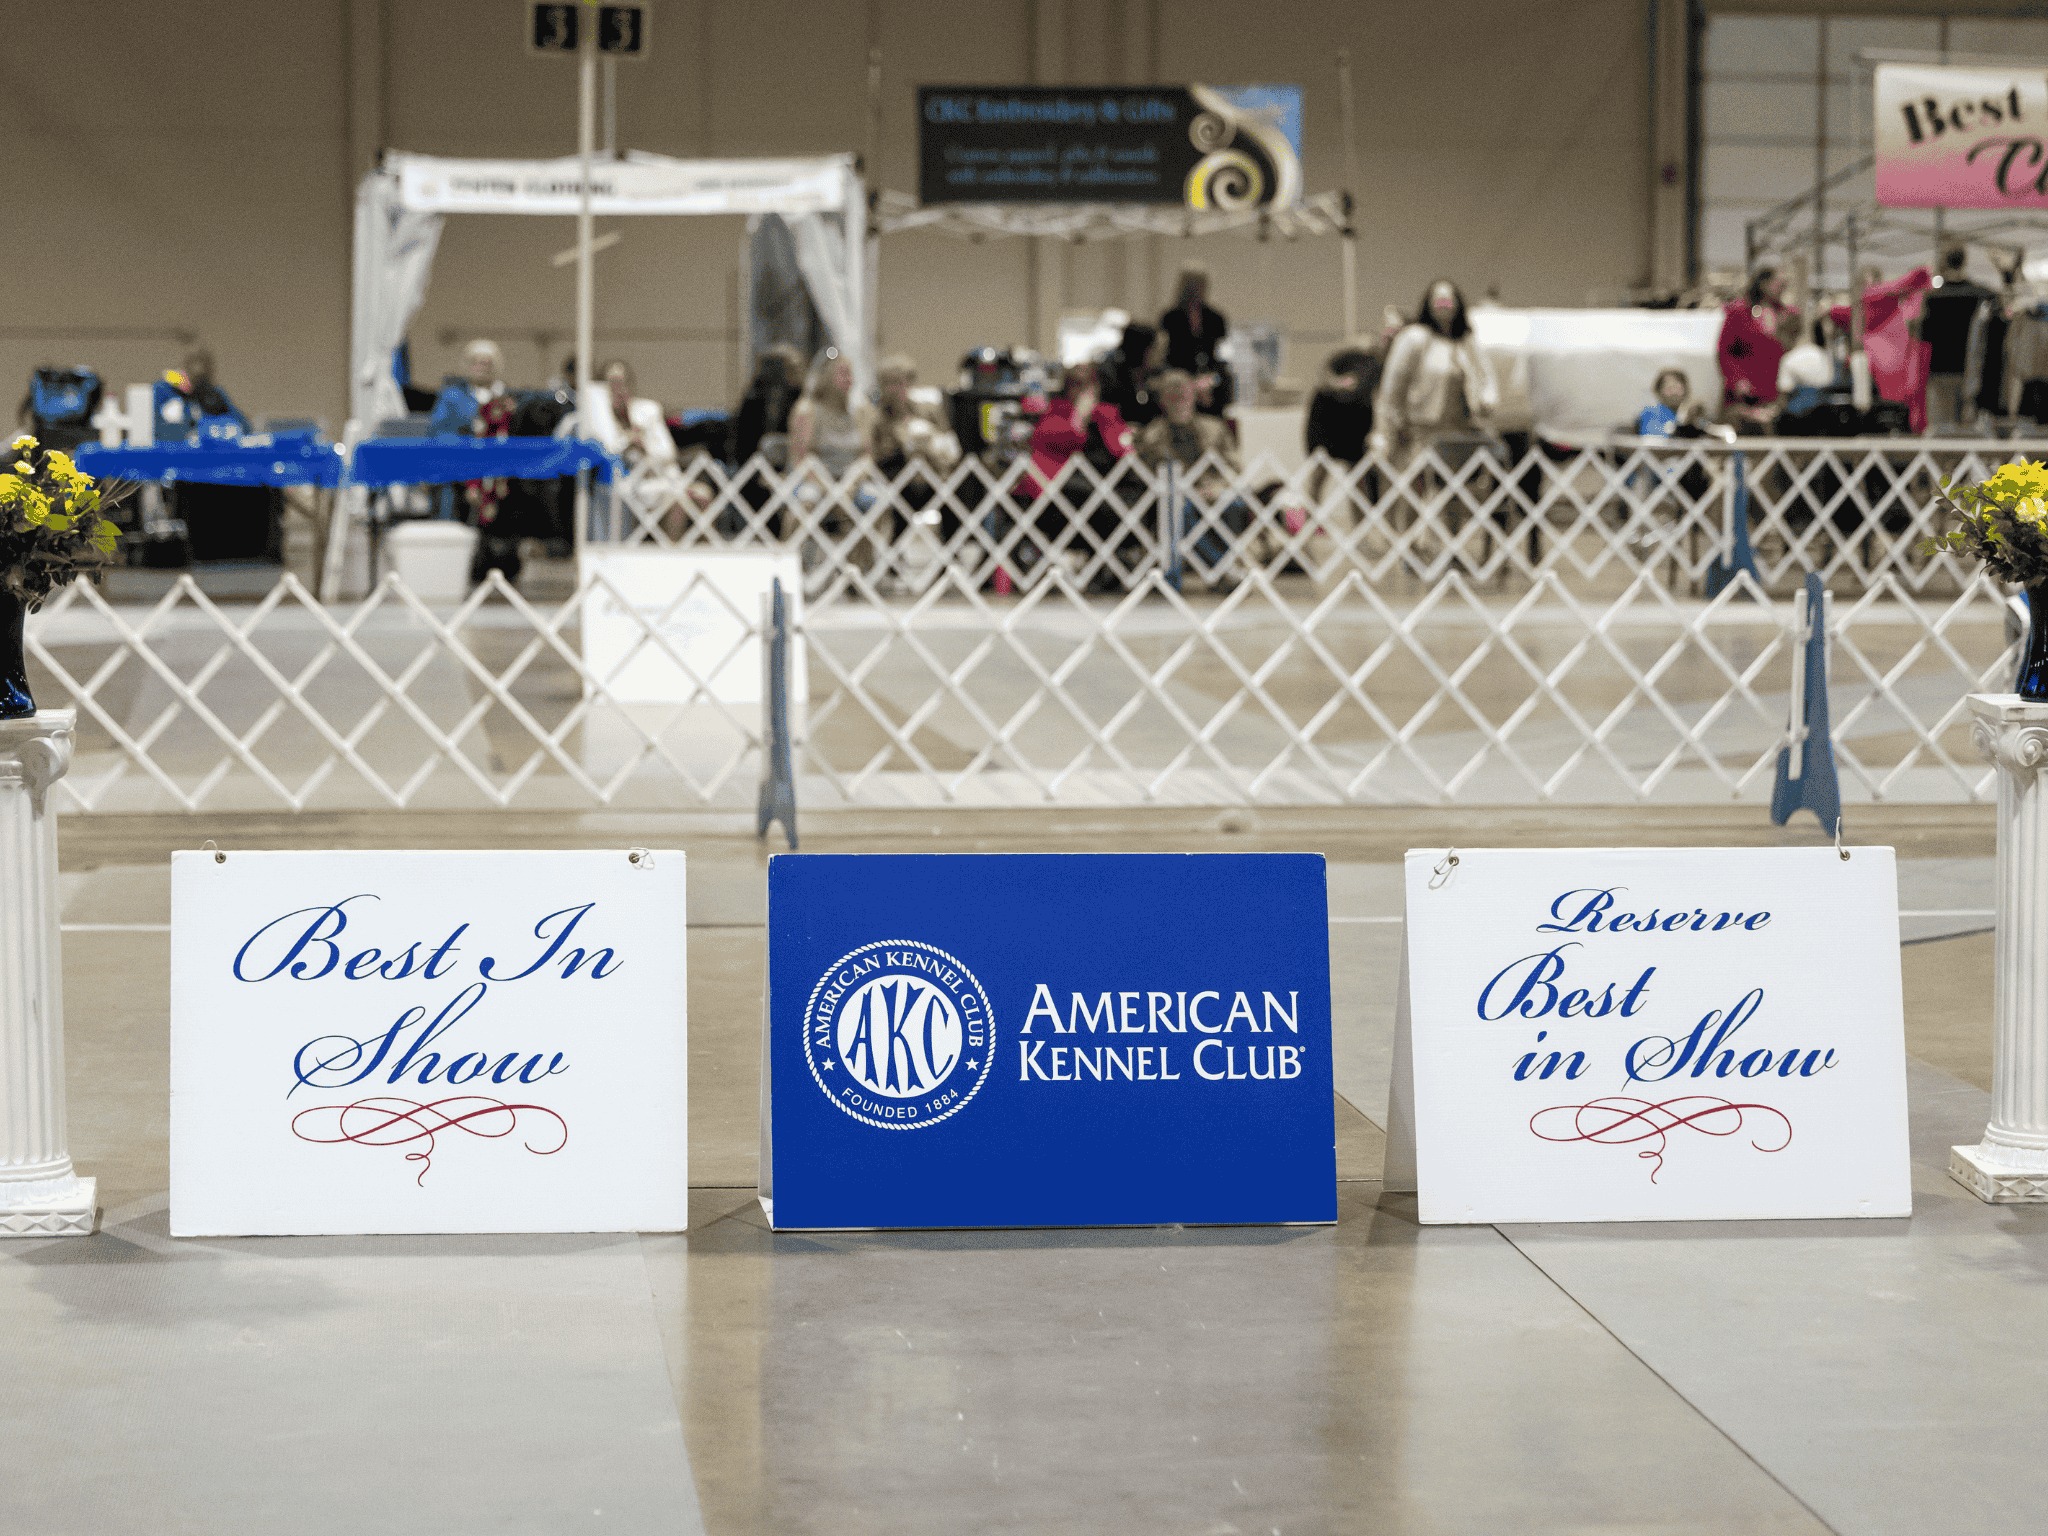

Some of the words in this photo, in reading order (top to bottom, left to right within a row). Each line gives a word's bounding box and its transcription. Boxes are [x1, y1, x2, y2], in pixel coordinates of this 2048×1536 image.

[1902, 86, 2021, 145] Best
[232, 893, 471, 983] Best
[478, 901, 625, 983] In
[1536, 886, 1772, 934] Reserve
[814, 954, 881, 1049] AMERICAN
[886, 950, 964, 994] KENNEL
[960, 993, 985, 1048] CLUB
[1019, 983, 1300, 1035] AMERICAN
[1476, 941, 1658, 1021] Best
[286, 982, 570, 1100] Show
[844, 978, 954, 1095] AKC
[1018, 1040, 1181, 1082] KENNEL
[1511, 1030, 1592, 1082] in
[1620, 987, 1840, 1093] Show
[841, 1086, 918, 1119] FOUNDED
[924, 1088, 959, 1114] 1884
